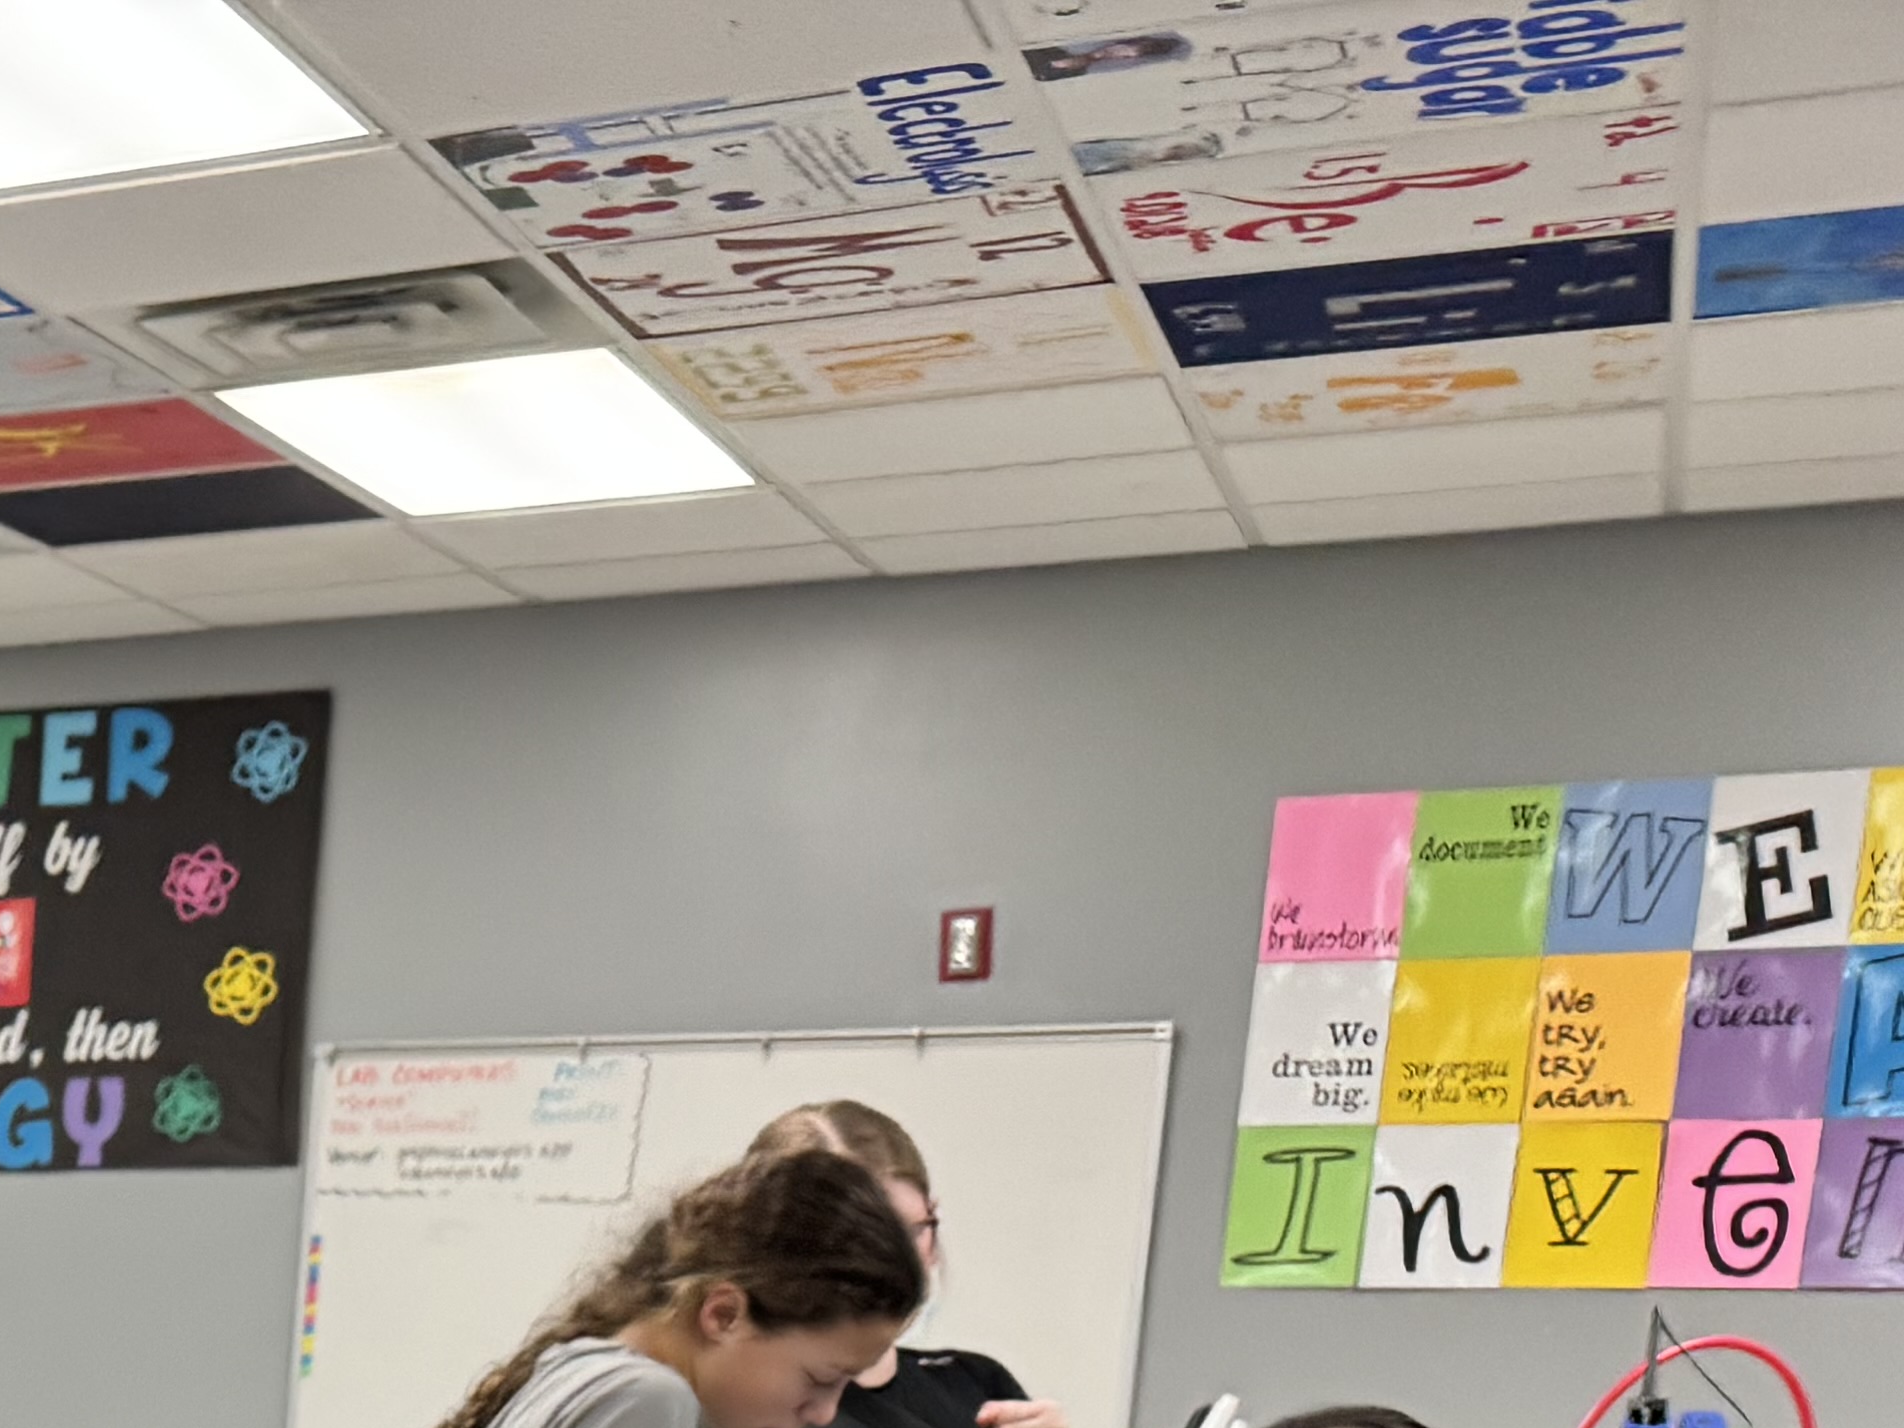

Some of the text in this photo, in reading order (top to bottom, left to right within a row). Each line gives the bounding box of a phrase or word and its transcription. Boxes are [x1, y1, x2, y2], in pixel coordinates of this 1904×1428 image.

[1510, 803, 1550, 830] We
[44, 822, 102, 893] by
[1546, 988, 1595, 1014] We
[62, 1006, 159, 1064] then
[1328, 1021, 1378, 1047] We
[1272, 1052, 1374, 1078] dream
[1311, 1081, 1370, 1113] big.
